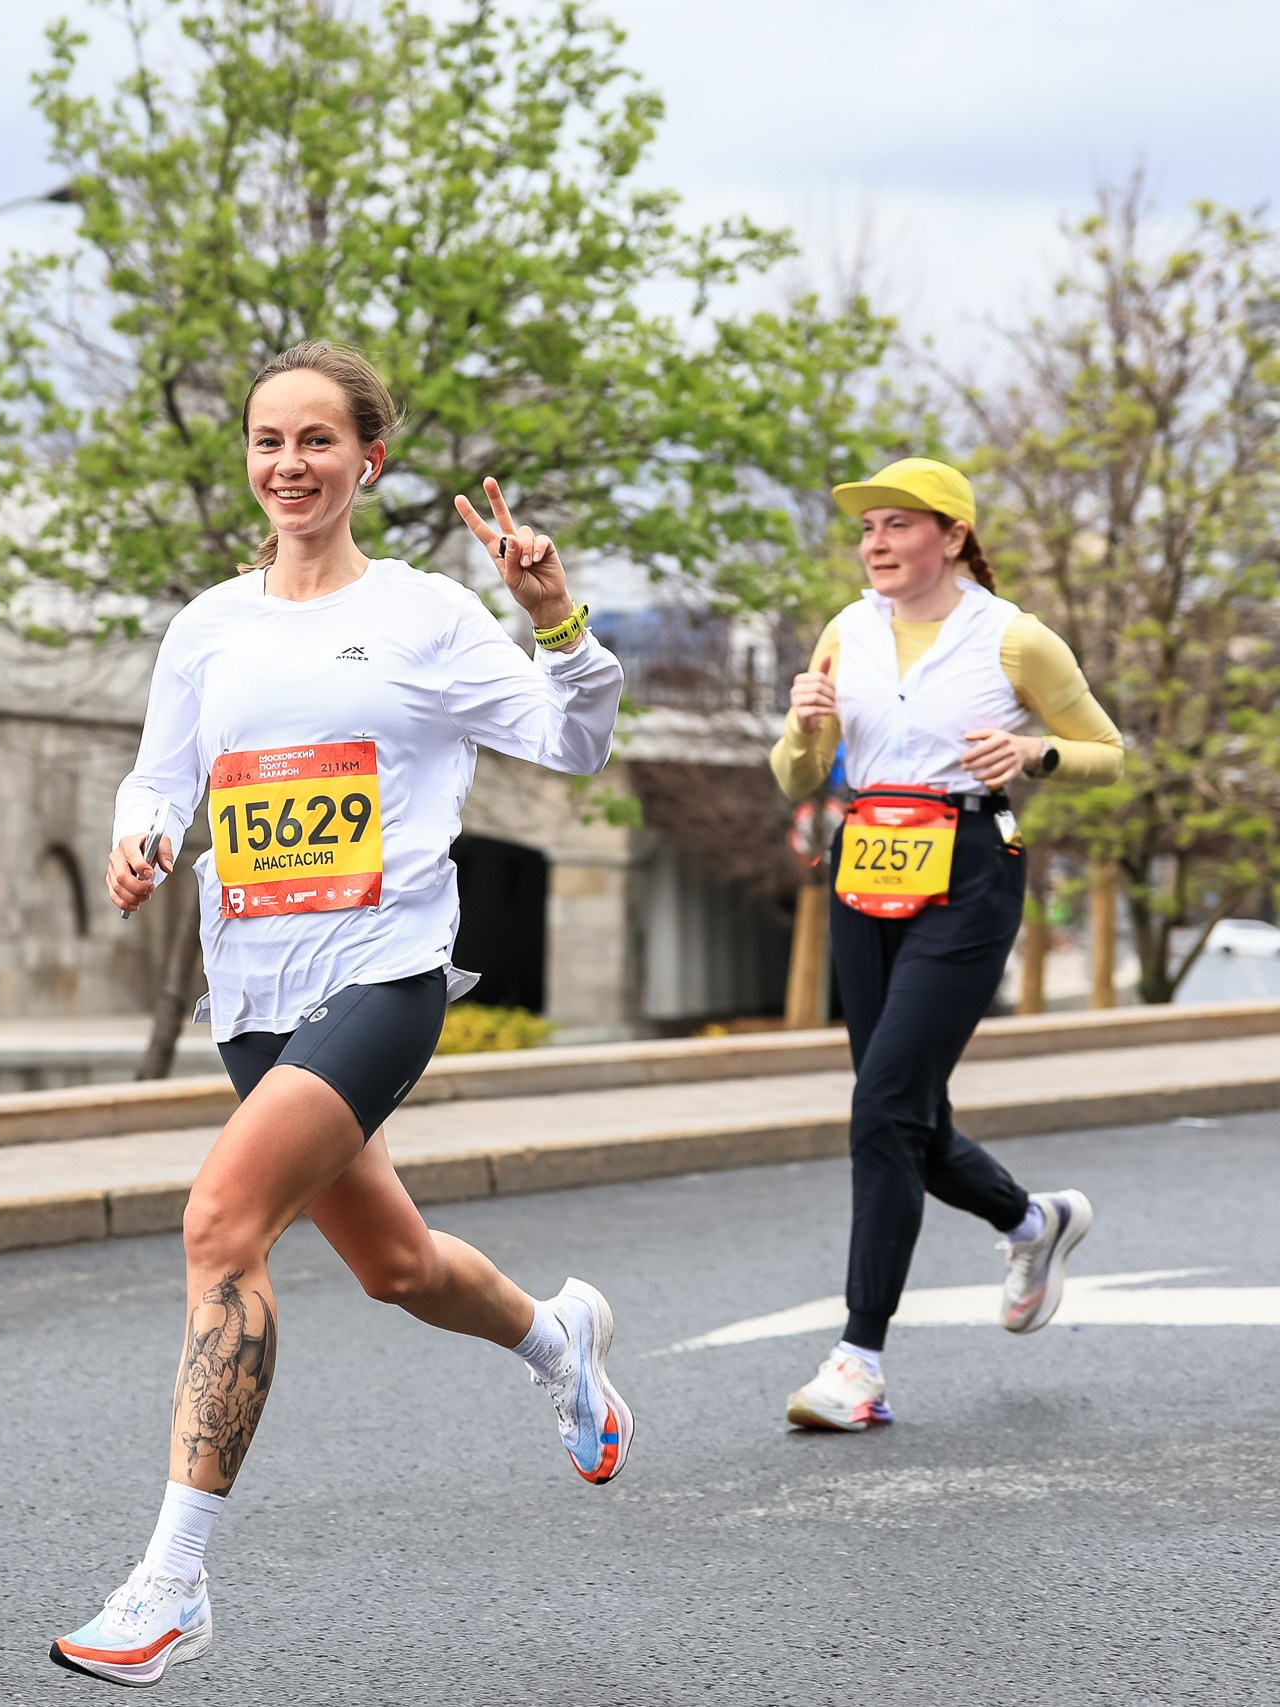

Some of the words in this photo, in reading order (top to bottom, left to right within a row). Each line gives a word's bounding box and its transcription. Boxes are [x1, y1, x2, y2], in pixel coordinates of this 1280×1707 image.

[259, 768, 300, 778] МАРАФОН
[219, 793, 372, 854] 15629
[253, 851, 334, 871] АНАСТАСИЯ
[854, 838, 934, 871] 2257
